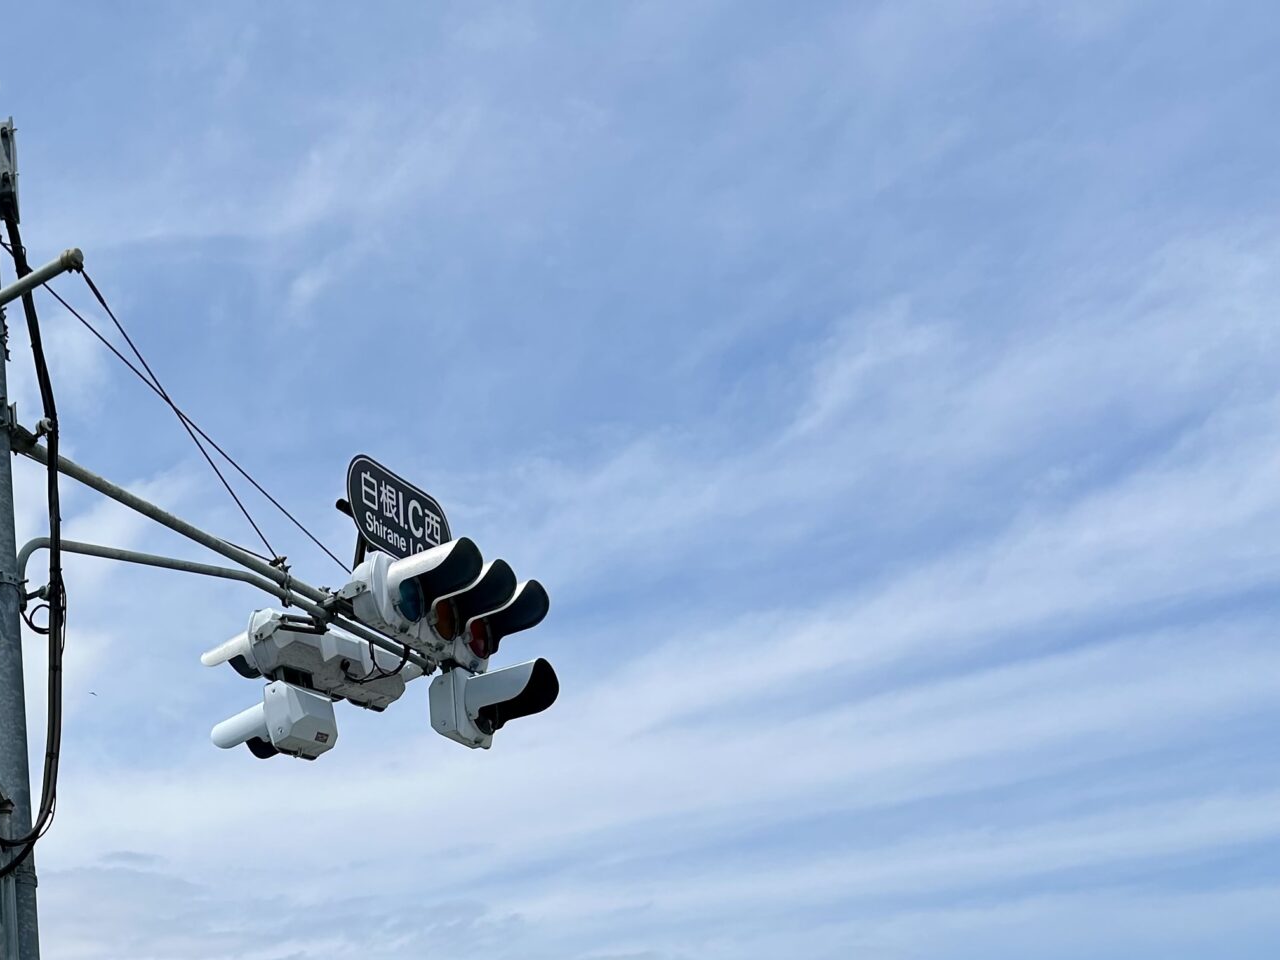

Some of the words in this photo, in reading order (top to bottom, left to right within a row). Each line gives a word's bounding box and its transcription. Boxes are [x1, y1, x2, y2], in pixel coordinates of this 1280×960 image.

[361, 471, 441, 547] 白根I.C西
[365, 511, 407, 552] Shirane
